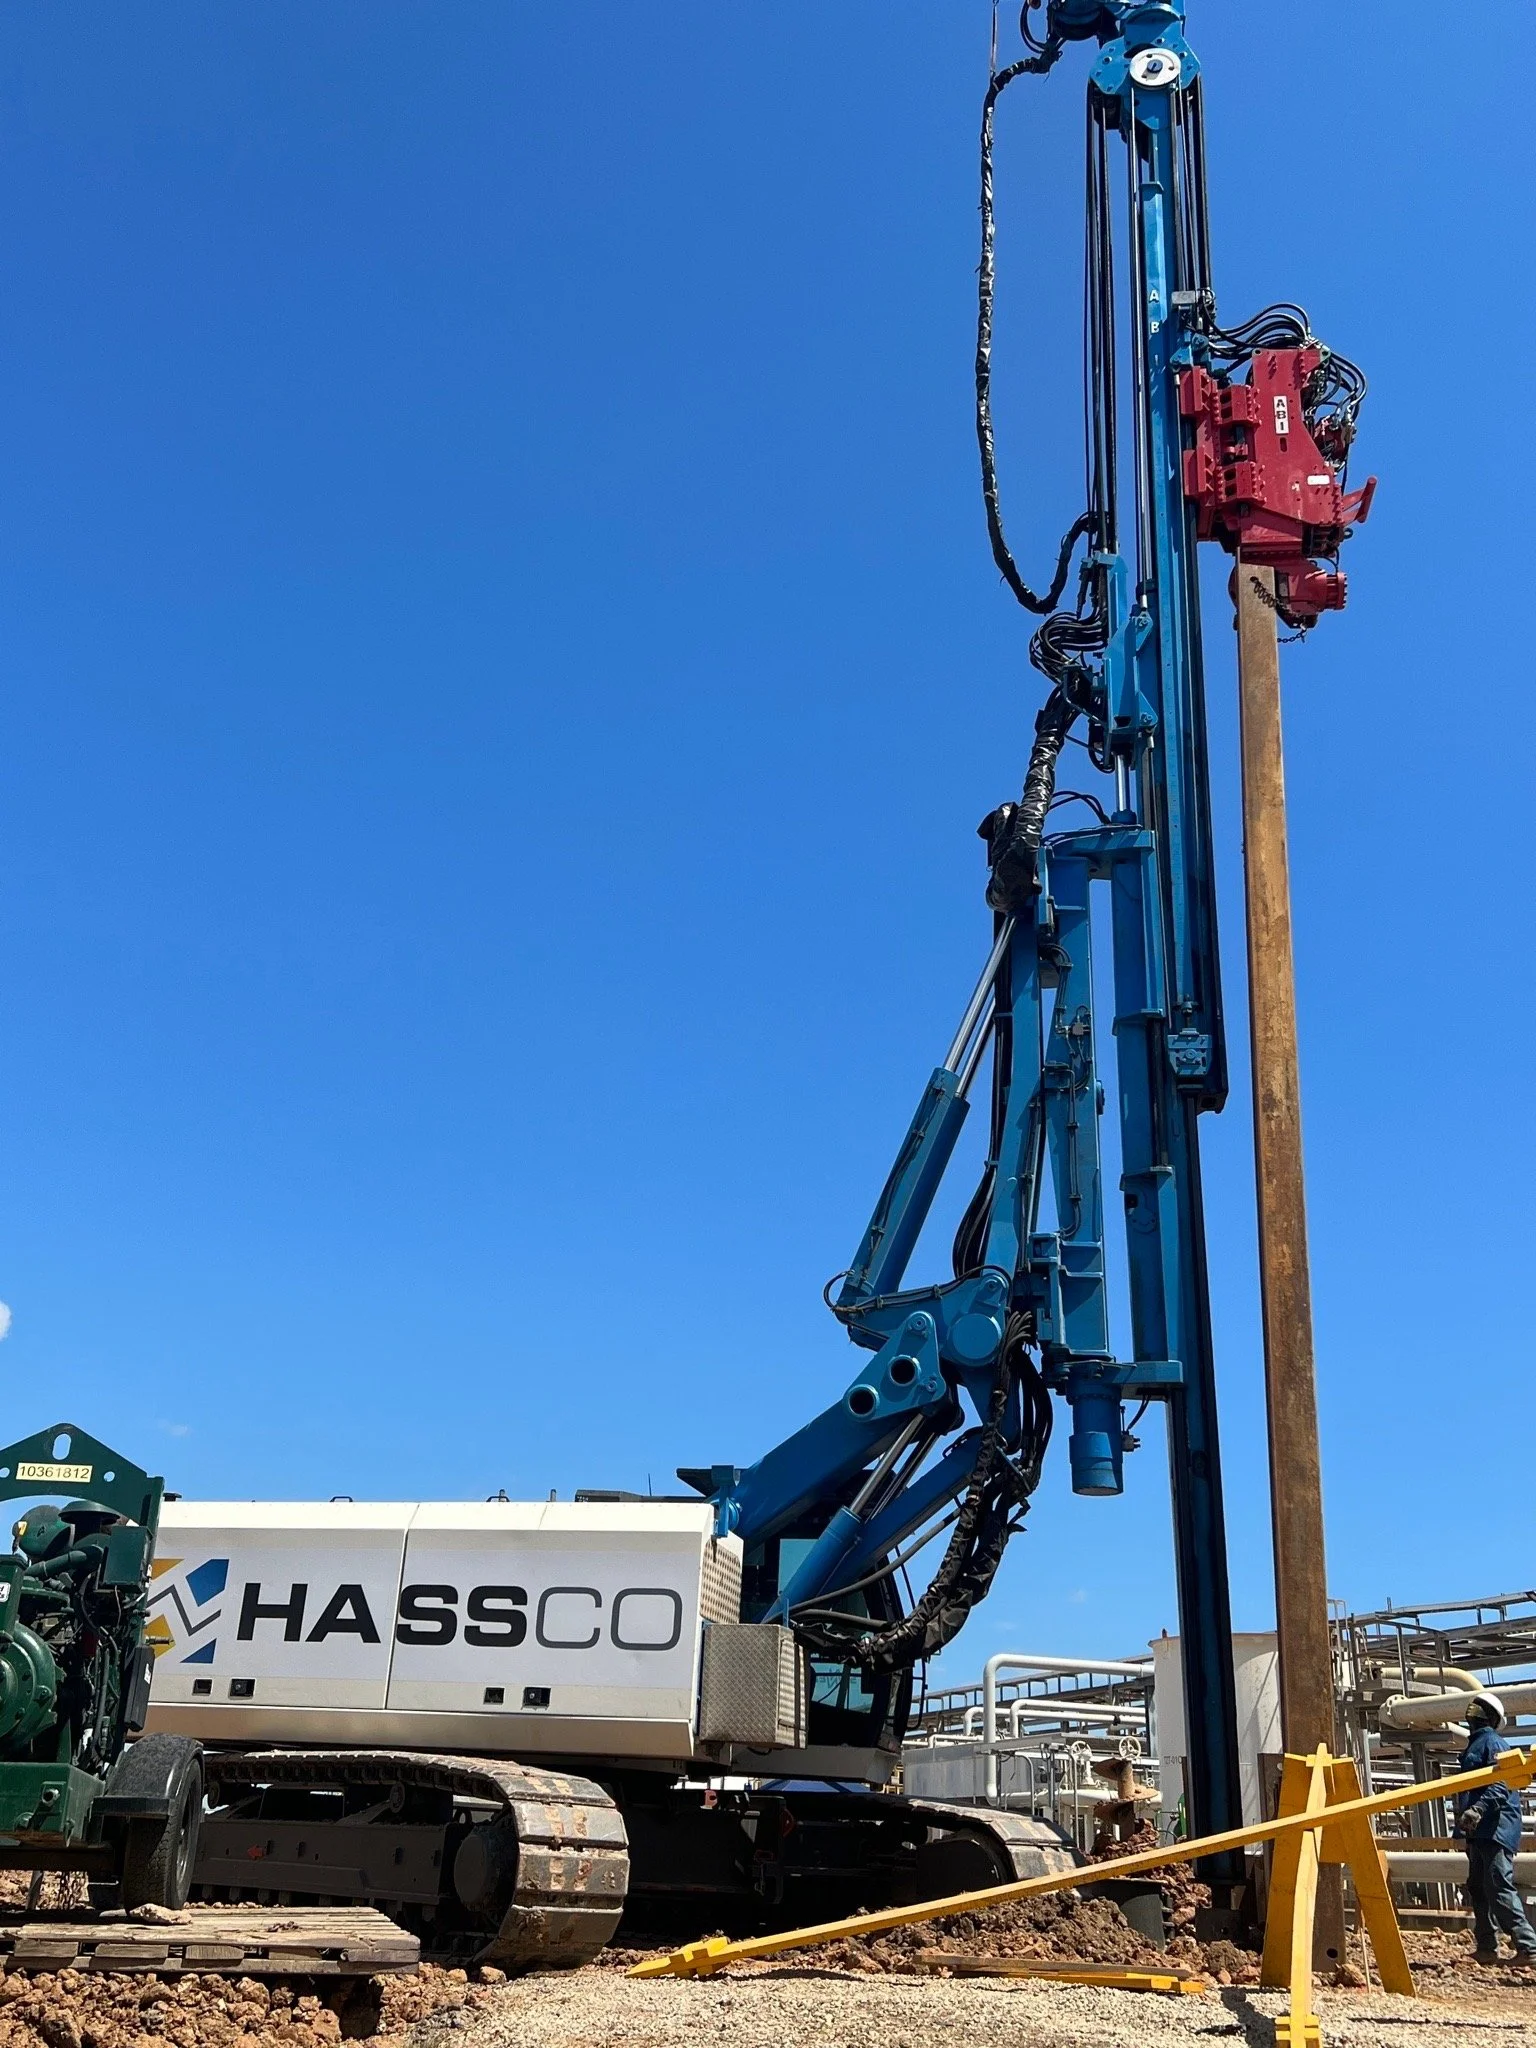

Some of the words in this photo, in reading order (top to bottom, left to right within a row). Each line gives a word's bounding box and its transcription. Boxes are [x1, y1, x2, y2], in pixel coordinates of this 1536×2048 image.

[1276, 398, 1287, 431] ABI
[19, 1465, 90, 1479] 10361812
[236, 1582, 683, 1651] HASSCO
